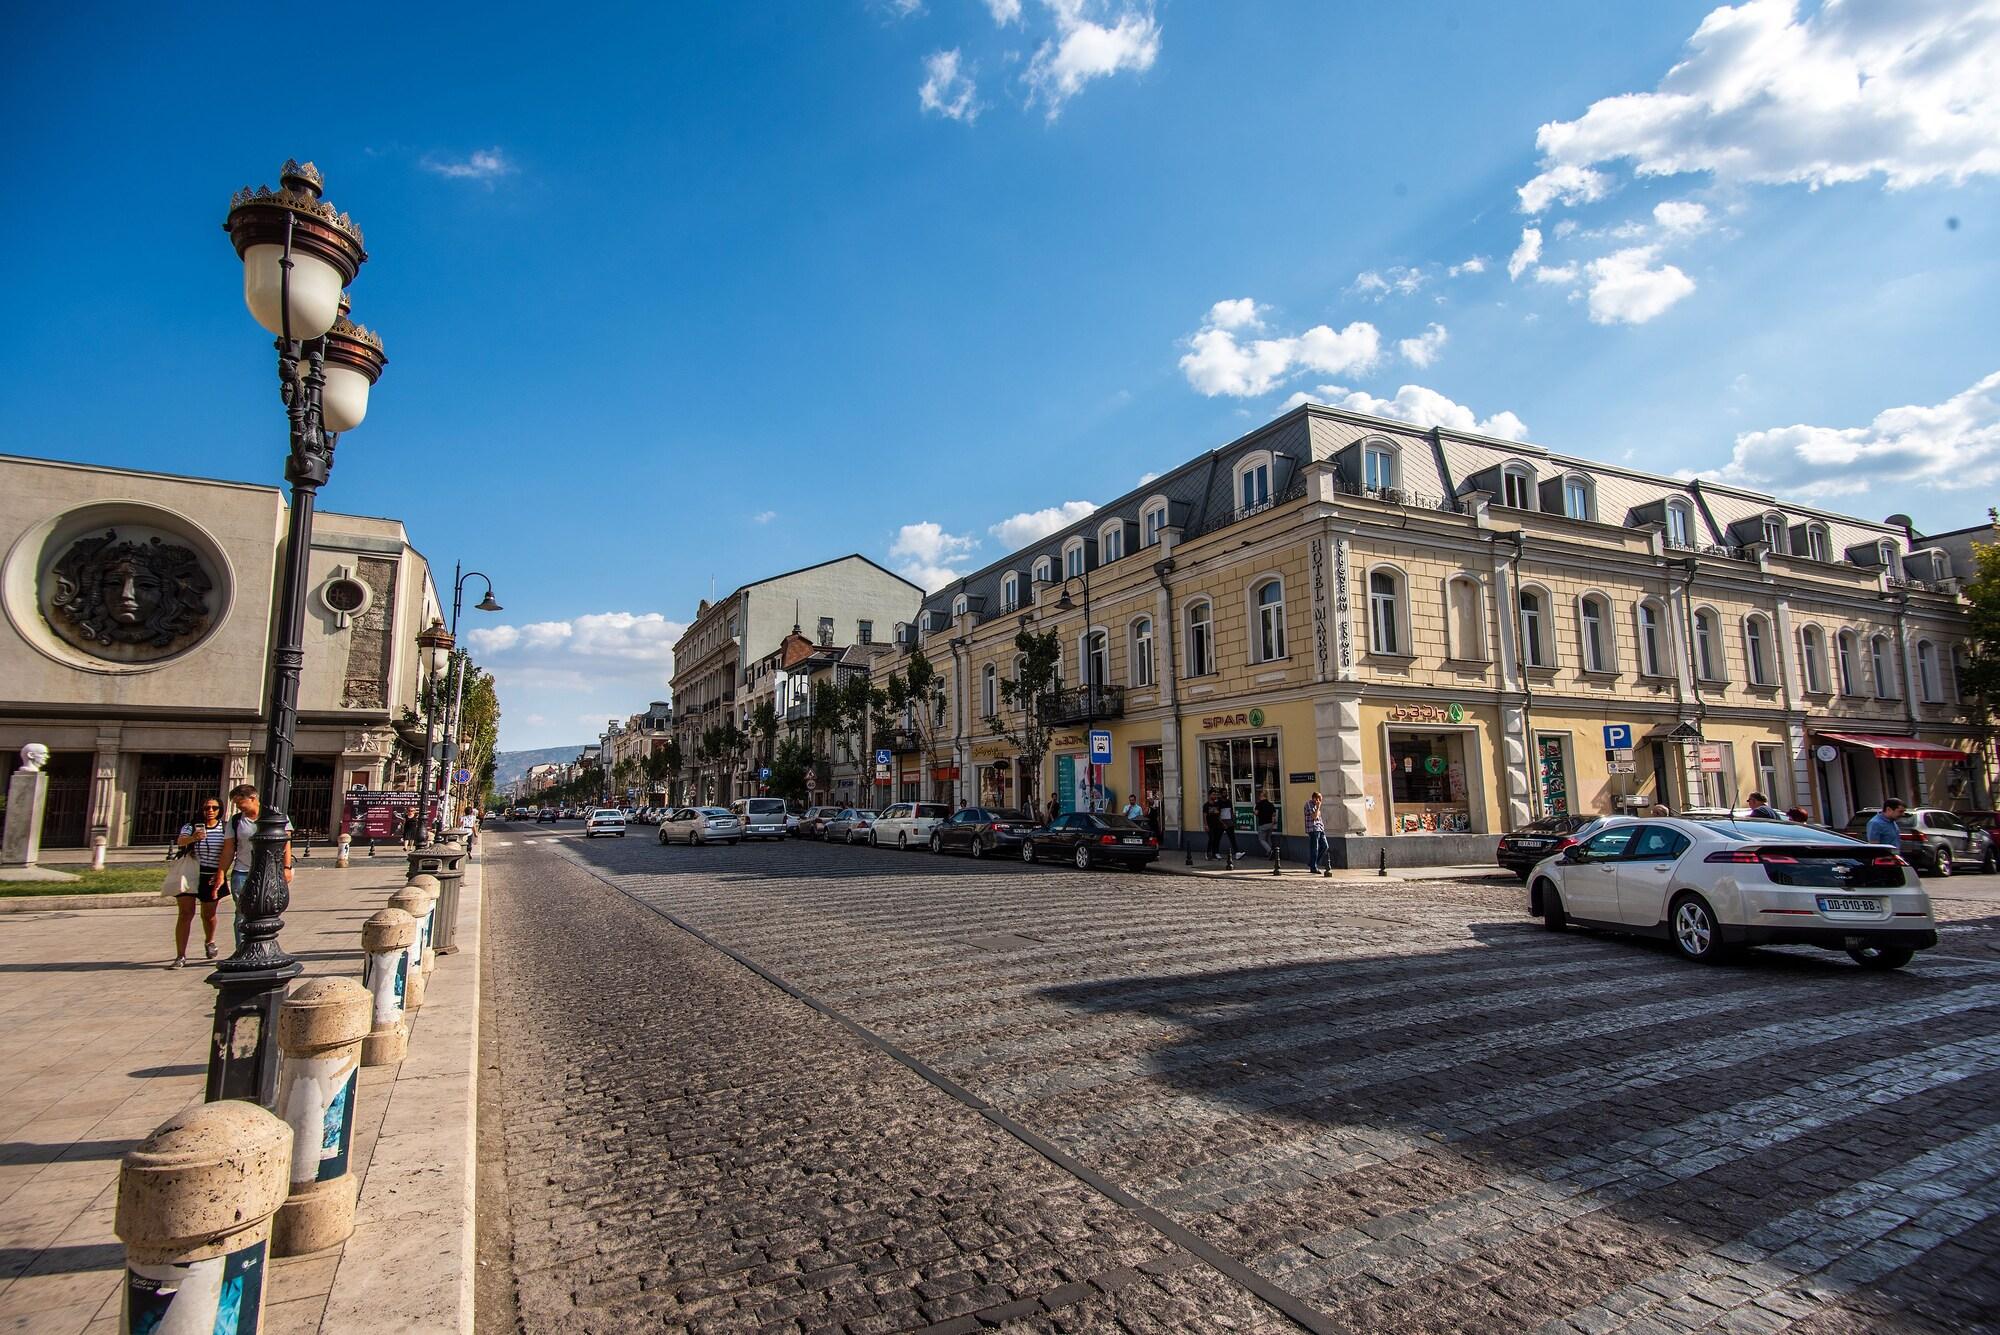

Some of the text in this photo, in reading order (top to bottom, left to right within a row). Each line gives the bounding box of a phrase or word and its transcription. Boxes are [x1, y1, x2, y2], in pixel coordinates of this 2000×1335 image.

[1312, 538, 1328, 674] HOTEL MARGI
[1202, 713, 1248, 729] SPAR
[1609, 728, 1625, 747] P
[762, 769, 769, 778] P
[1828, 899, 1875, 911] DD-010-BB
